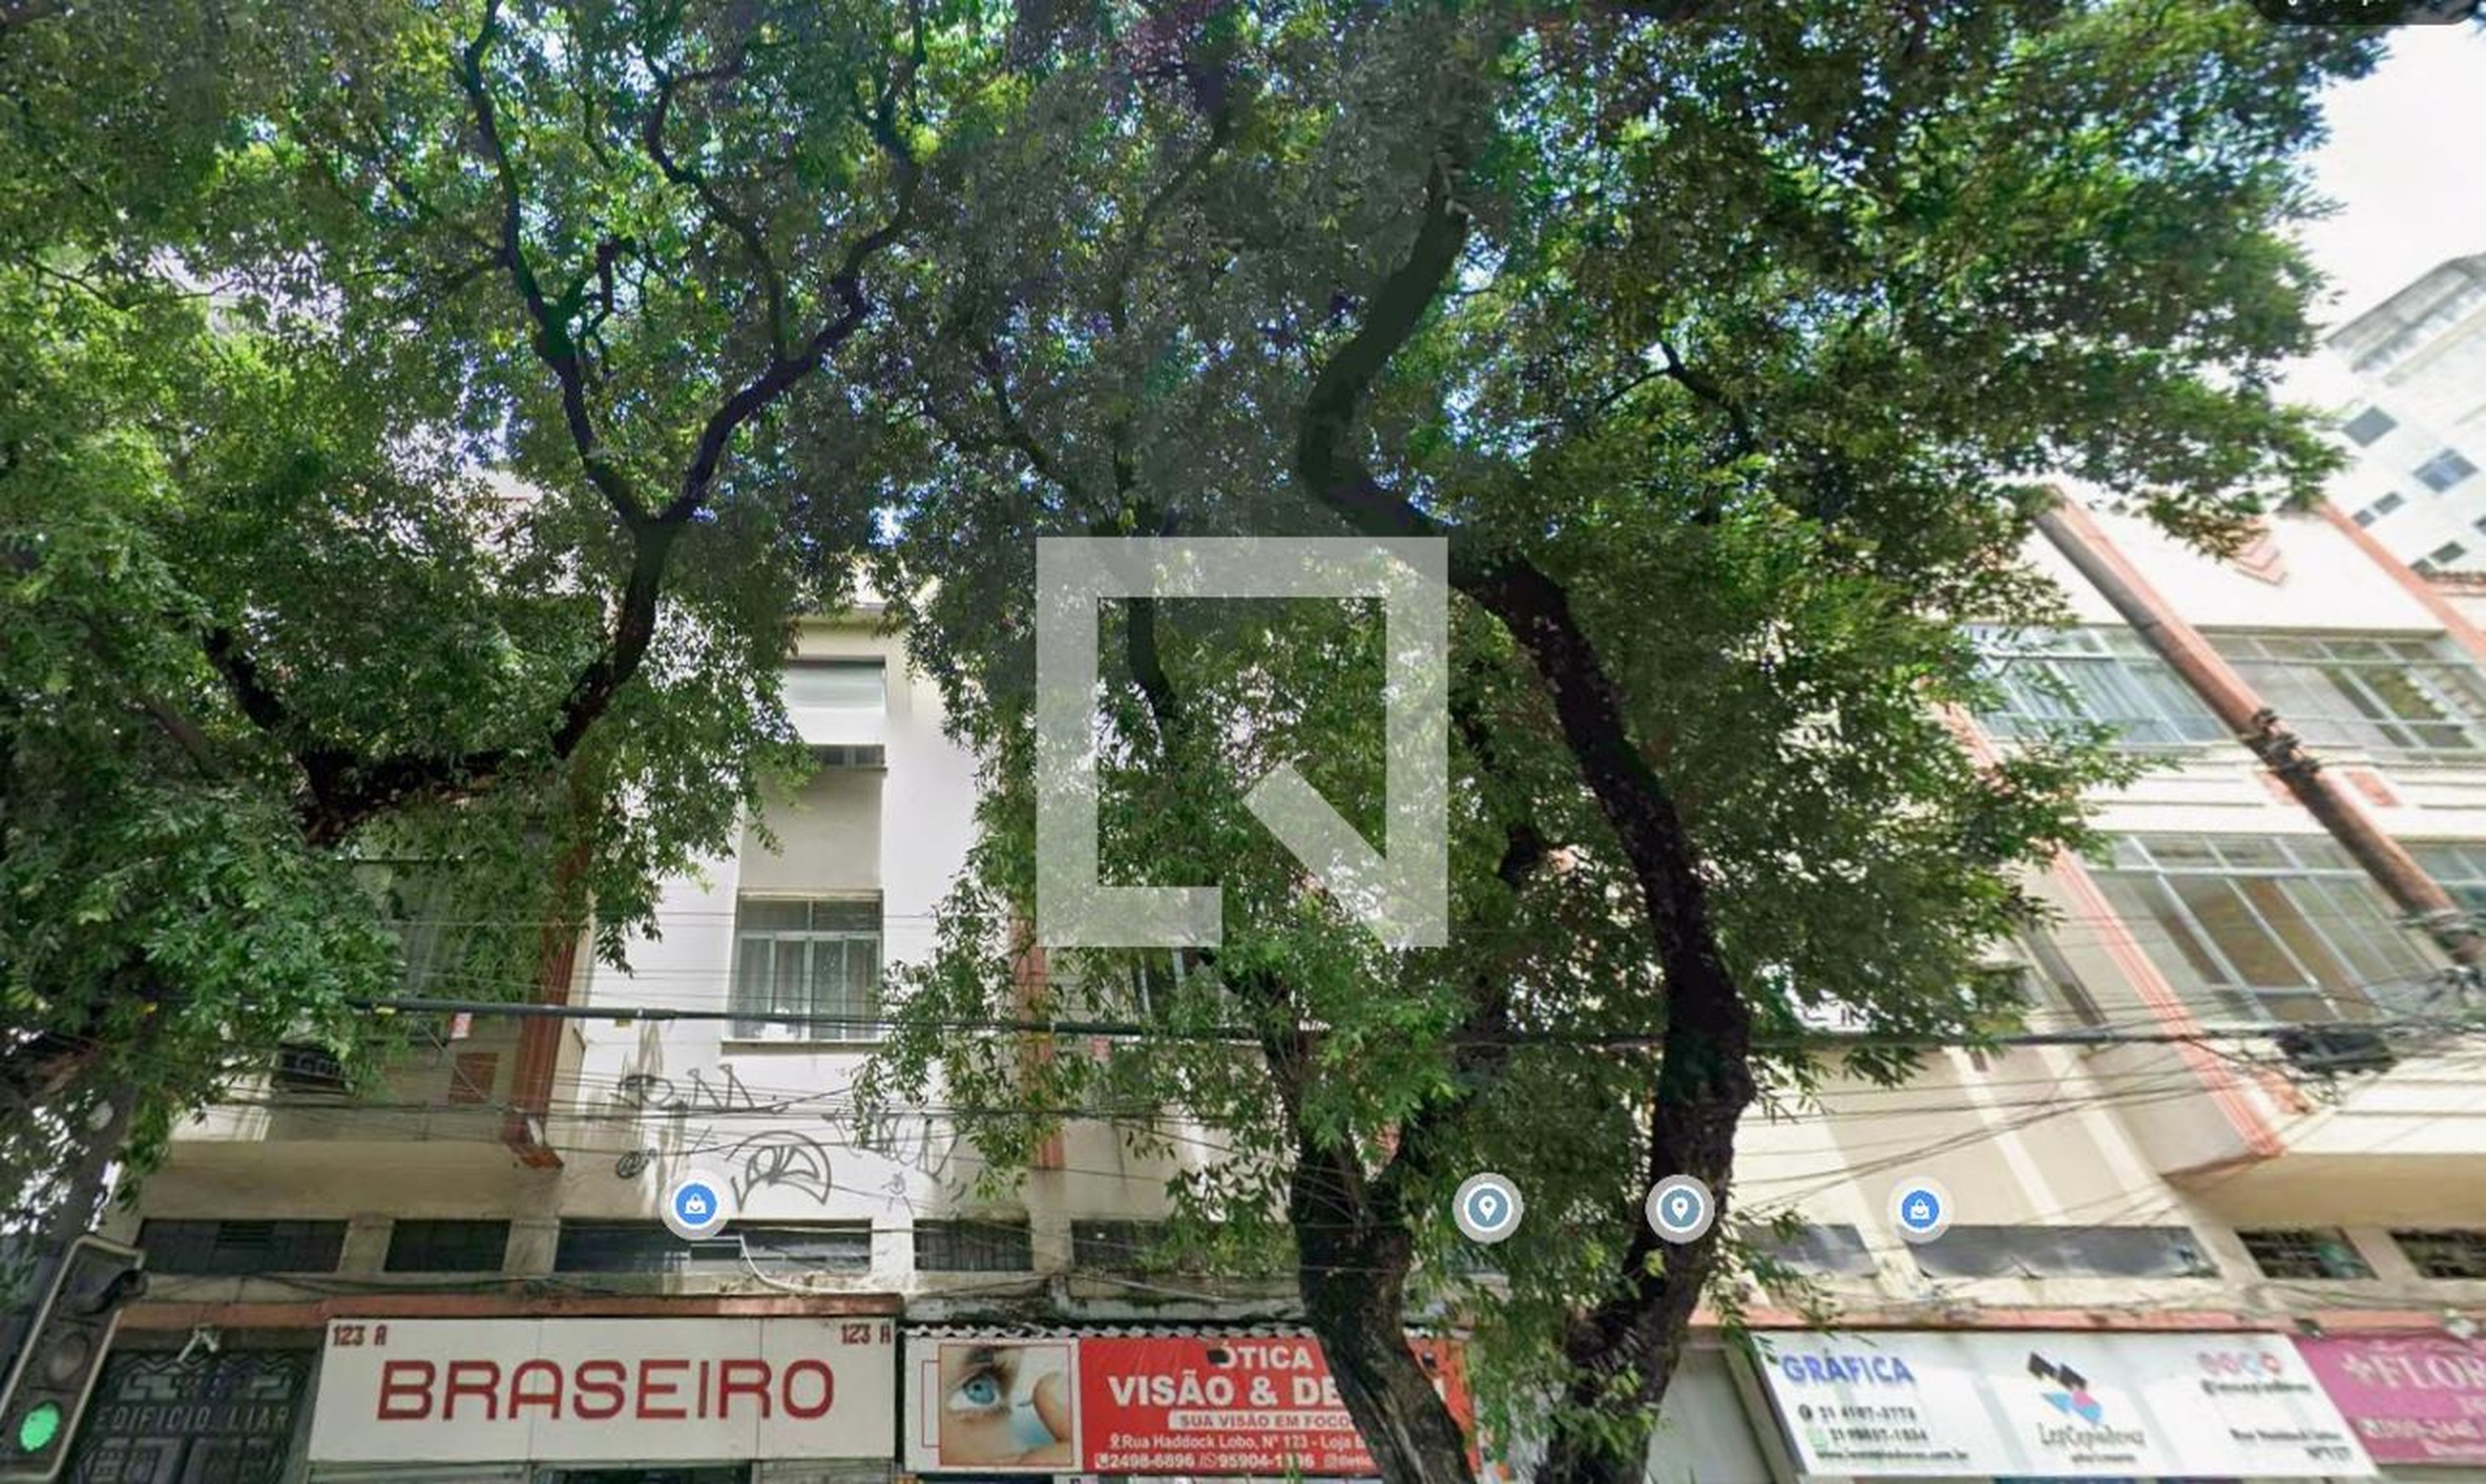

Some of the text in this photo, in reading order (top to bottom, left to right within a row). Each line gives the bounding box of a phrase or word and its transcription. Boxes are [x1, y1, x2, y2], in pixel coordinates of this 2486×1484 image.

[332, 1325, 388, 1346] 123 A
[842, 1325, 891, 1344] 123 A
[376, 1360, 834, 1420] BRASEIRO
[1106, 1368, 1235, 1407] VISÃO
[1249, 1375, 1279, 1407] &
[1122, 1434, 1150, 1450] Rua
[1153, 1433, 1215, 1450] Haddock
[1319, 1434, 1352, 1453] Loja
